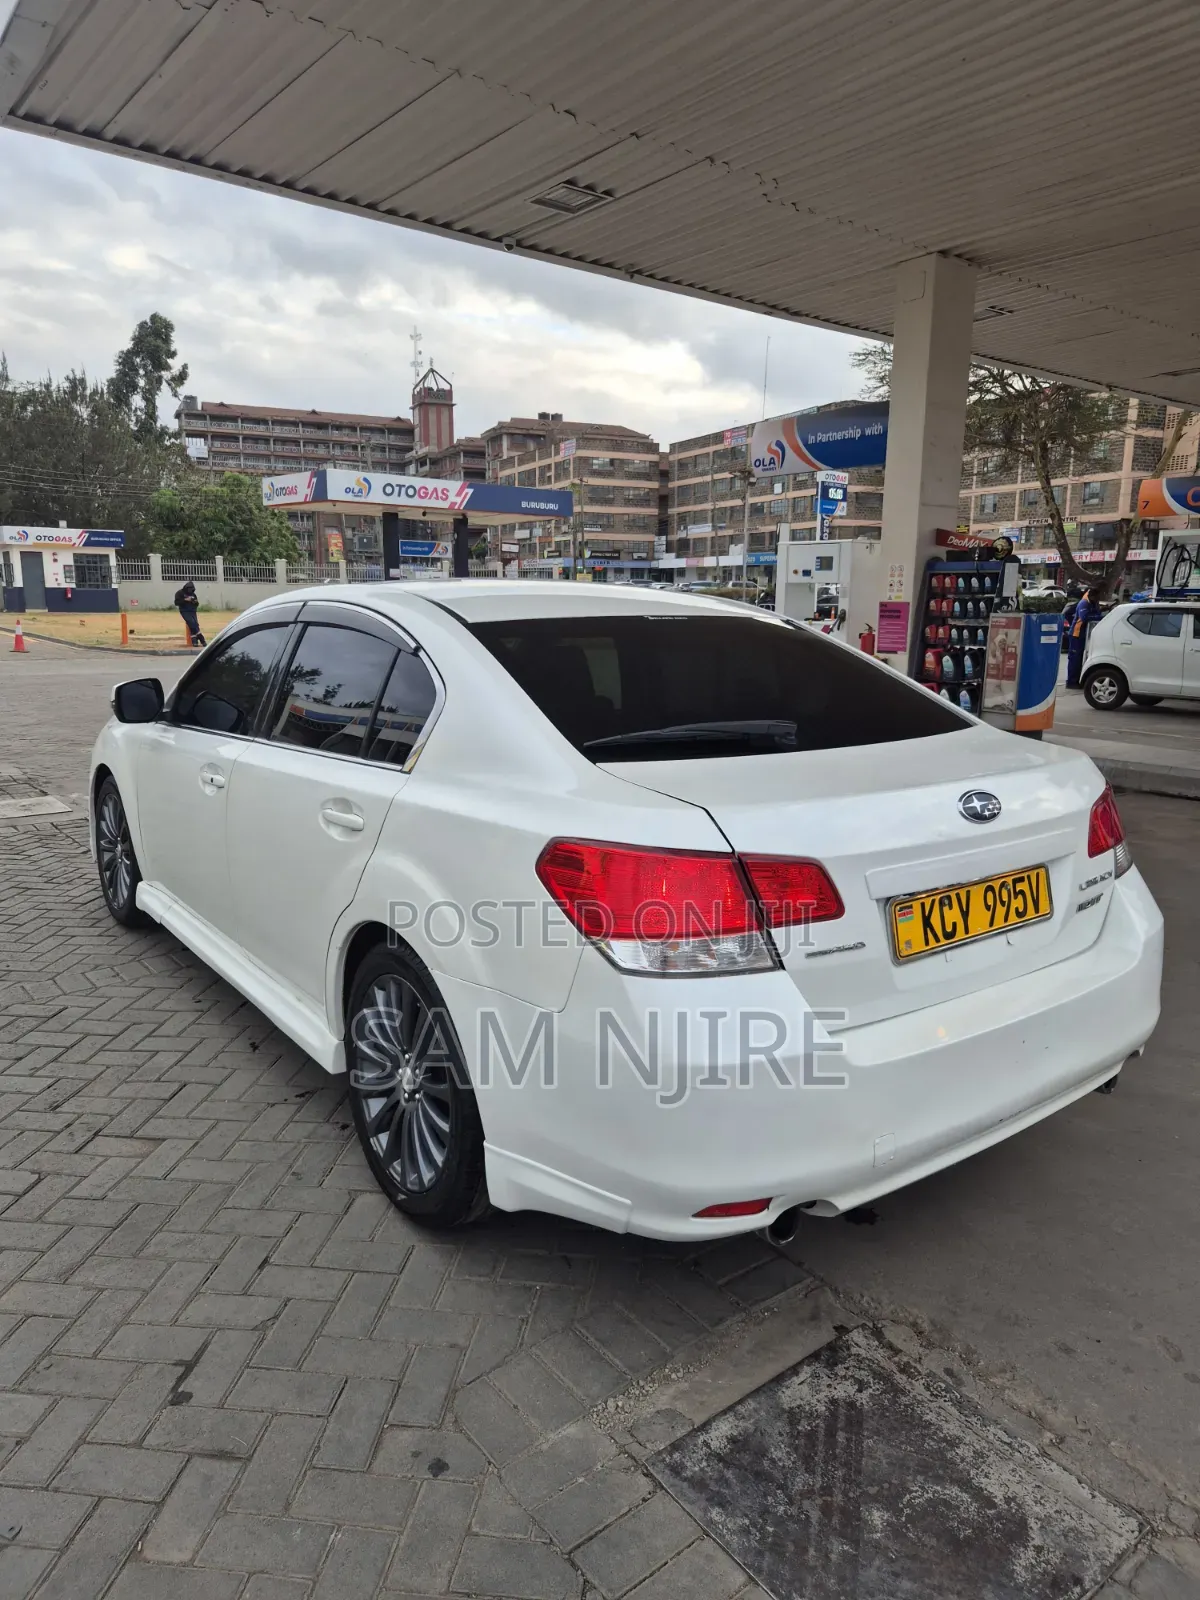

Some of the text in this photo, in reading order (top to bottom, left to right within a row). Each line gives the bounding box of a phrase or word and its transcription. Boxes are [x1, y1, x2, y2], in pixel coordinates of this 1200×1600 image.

[808, 422, 883, 445] In Partnership with
[754, 456, 776, 469] OLA
[825, 473, 847, 482] OTOGAS
[275, 485, 298, 497] OTOGAS
[344, 486, 363, 495] OLA
[382, 482, 450, 502] OTOGAS
[521, 500, 559, 511] BURUBURU
[1142, 500, 1150, 510] 7
[35, 534, 73, 543] OTOGAS
[920, 874, 1041, 946] KCY 995V
